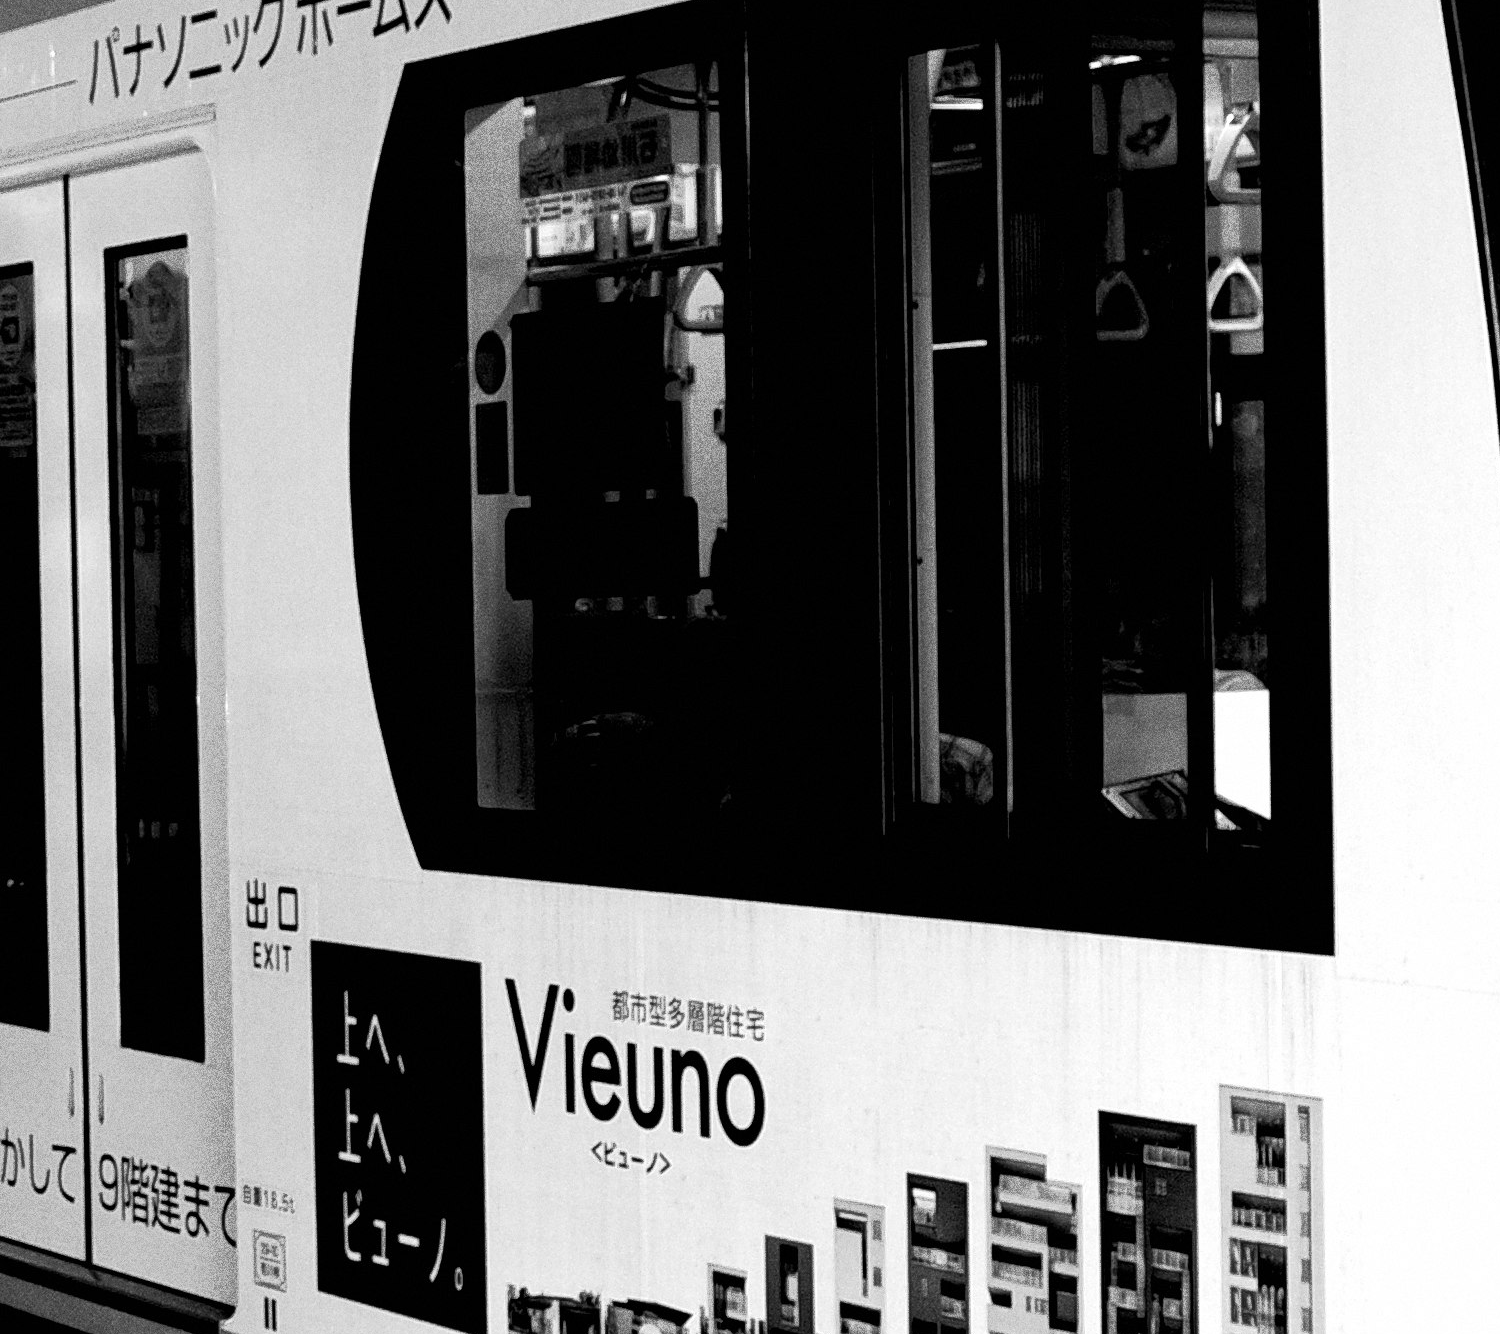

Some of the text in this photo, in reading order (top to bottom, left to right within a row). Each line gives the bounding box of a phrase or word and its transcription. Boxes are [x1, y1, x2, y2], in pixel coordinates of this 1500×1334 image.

[246, 878, 299, 932] 出口
[252, 941, 293, 973] EXIT
[612, 989, 766, 1043] 都市型多層階住宅
[505, 978, 766, 1148] Vieuno
[342, 1188, 464, 1292] ビューノ。
